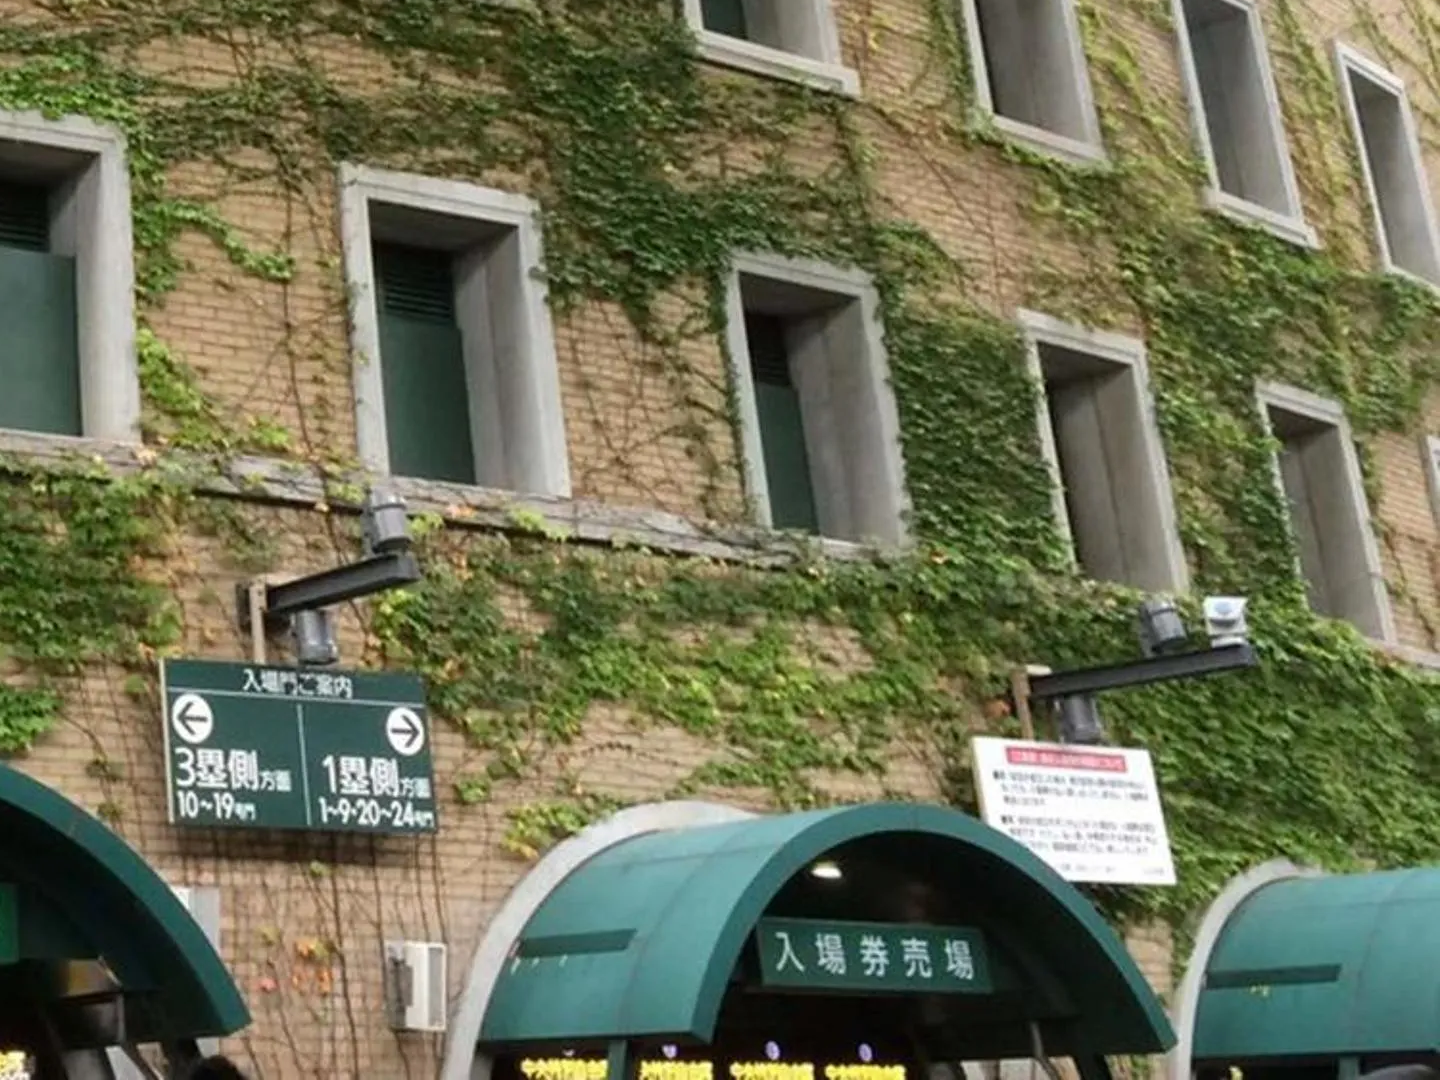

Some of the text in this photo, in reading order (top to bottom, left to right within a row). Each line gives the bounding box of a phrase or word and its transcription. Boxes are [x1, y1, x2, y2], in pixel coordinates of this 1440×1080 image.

[775, 931, 975, 981] 入場券売場
